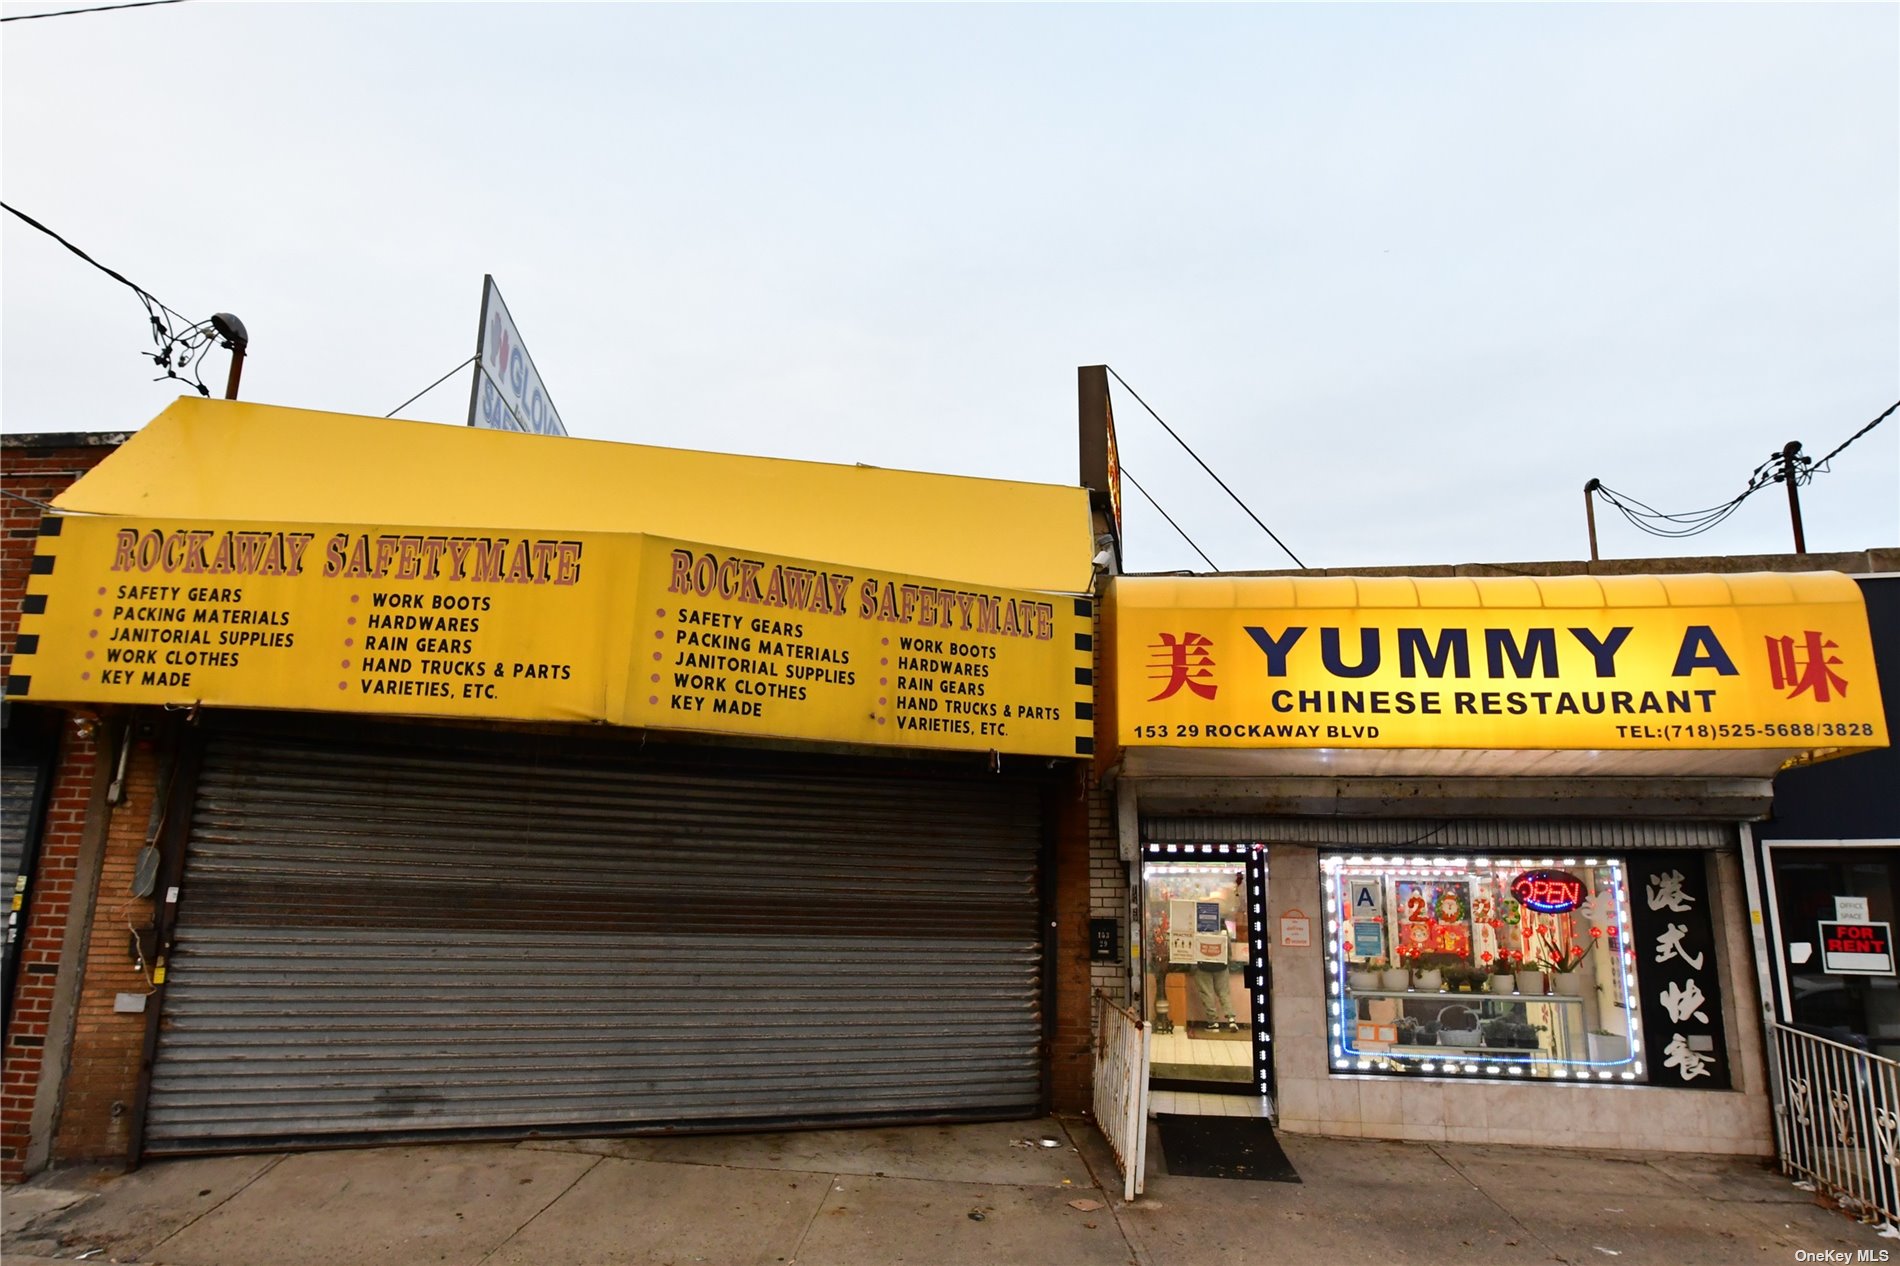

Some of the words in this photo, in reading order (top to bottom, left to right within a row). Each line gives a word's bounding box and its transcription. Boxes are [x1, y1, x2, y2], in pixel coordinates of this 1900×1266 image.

[111, 528, 314, 576] ROCKAWAY
[322, 533, 582, 586] SAFETYMATE
[117, 585, 181, 601] SAFETY
[188, 588, 242, 603] GEARS
[372, 593, 424, 609] WORK
[432, 595, 491, 611] BOOTS
[668, 548, 853, 616] ROCKAWAY
[859, 578, 1053, 640] SAFETYMATE
[113, 606, 186, 622] PACKING
[193, 610, 290, 626] MATERIALS
[368, 614, 479, 633] HARDWARES
[678, 608, 743, 630] SAFETY
[751, 618, 803, 638] GEARS
[110, 627, 211, 645] JANITORIAL
[219, 631, 294, 648] SUPPLIES
[365, 636, 408, 652] RAIN
[416, 637, 473, 654] GEARS
[676, 630, 750, 652] PACKING
[758, 640, 850, 664] MATERIALS
[900, 636, 943, 654] WORK
[950, 642, 996, 660] BOOTS
[107, 648, 157, 665] WORK
[166, 651, 239, 667] CLOTHES
[1243, 626, 1634, 679] YUMMY
[1671, 624, 1740, 677] A
[362, 657, 412, 674] HAND
[421, 659, 486, 676] TRUCKS
[494, 662, 505, 678] &
[513, 663, 571, 680] PARTS
[675, 651, 778, 677] JANITORIAL
[786, 664, 856, 685] SUPPLIES
[898, 656, 989, 678] HARDWARES
[1145, 631, 1218, 702] 美
[1764, 630, 1849, 703] 味
[101, 669, 135, 685] KEY
[142, 671, 191, 687] MADE
[674, 672, 727, 692] WORK
[735, 679, 807, 701] CLOTHES
[897, 676, 933, 692] RAIN
[940, 680, 985, 697] GEARS
[361, 679, 455, 700] VARIETIES,
[463, 683, 498, 700] ETC.
[671, 694, 704, 711] KEY
[713, 699, 762, 717] MADE
[896, 696, 938, 712] HAND
[945, 700, 997, 717] TRUCKS
[1003, 704, 1012, 718] &
[1018, 705, 1060, 721] PARTS
[1271, 689, 1442, 714] CHINESE
[1455, 689, 1717, 715] RESTAURANT
[897, 715, 975, 736] VARIETIES,
[981, 722, 1008, 737] ETC.
[1134, 725, 1168, 739] 153
[1176, 725, 1199, 739] 29
[1205, 724, 1320, 738] ROCKAWAY
[1327, 725, 1380, 739] BLVD
[1357, 887, 1375, 906] A
[1516, 880, 1580, 904] OPEN
[1836, 926, 1873, 939] FOR
[1826, 938, 1885, 953] RENT
